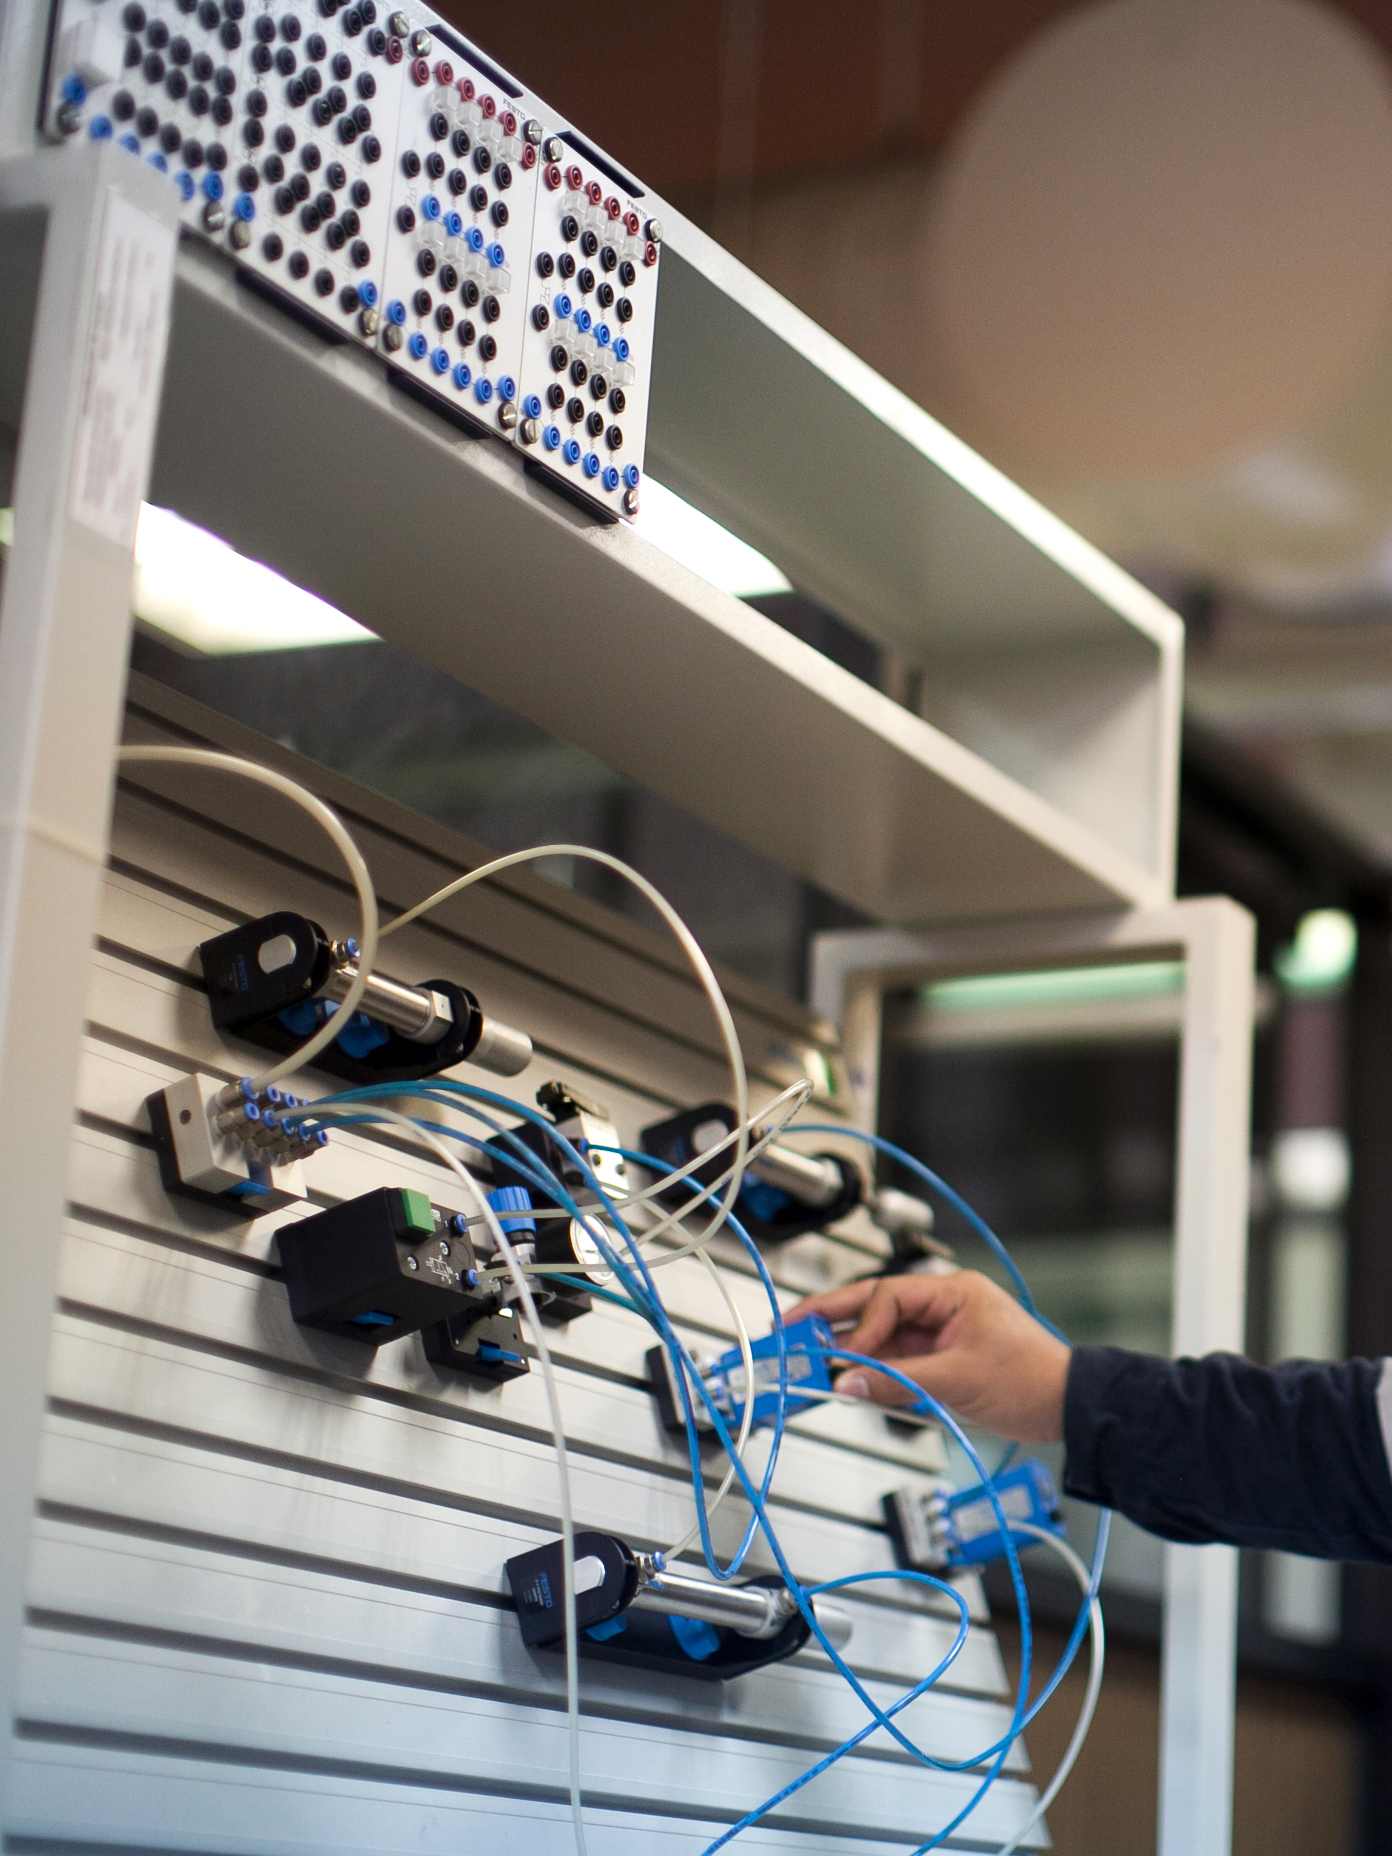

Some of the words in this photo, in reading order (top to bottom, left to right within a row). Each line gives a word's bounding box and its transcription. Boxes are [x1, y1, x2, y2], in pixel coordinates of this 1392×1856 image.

[503, 98, 526, 121] FESTO
[627, 199, 648, 220] FESTO
[540, 1571, 553, 1609] FESTO
